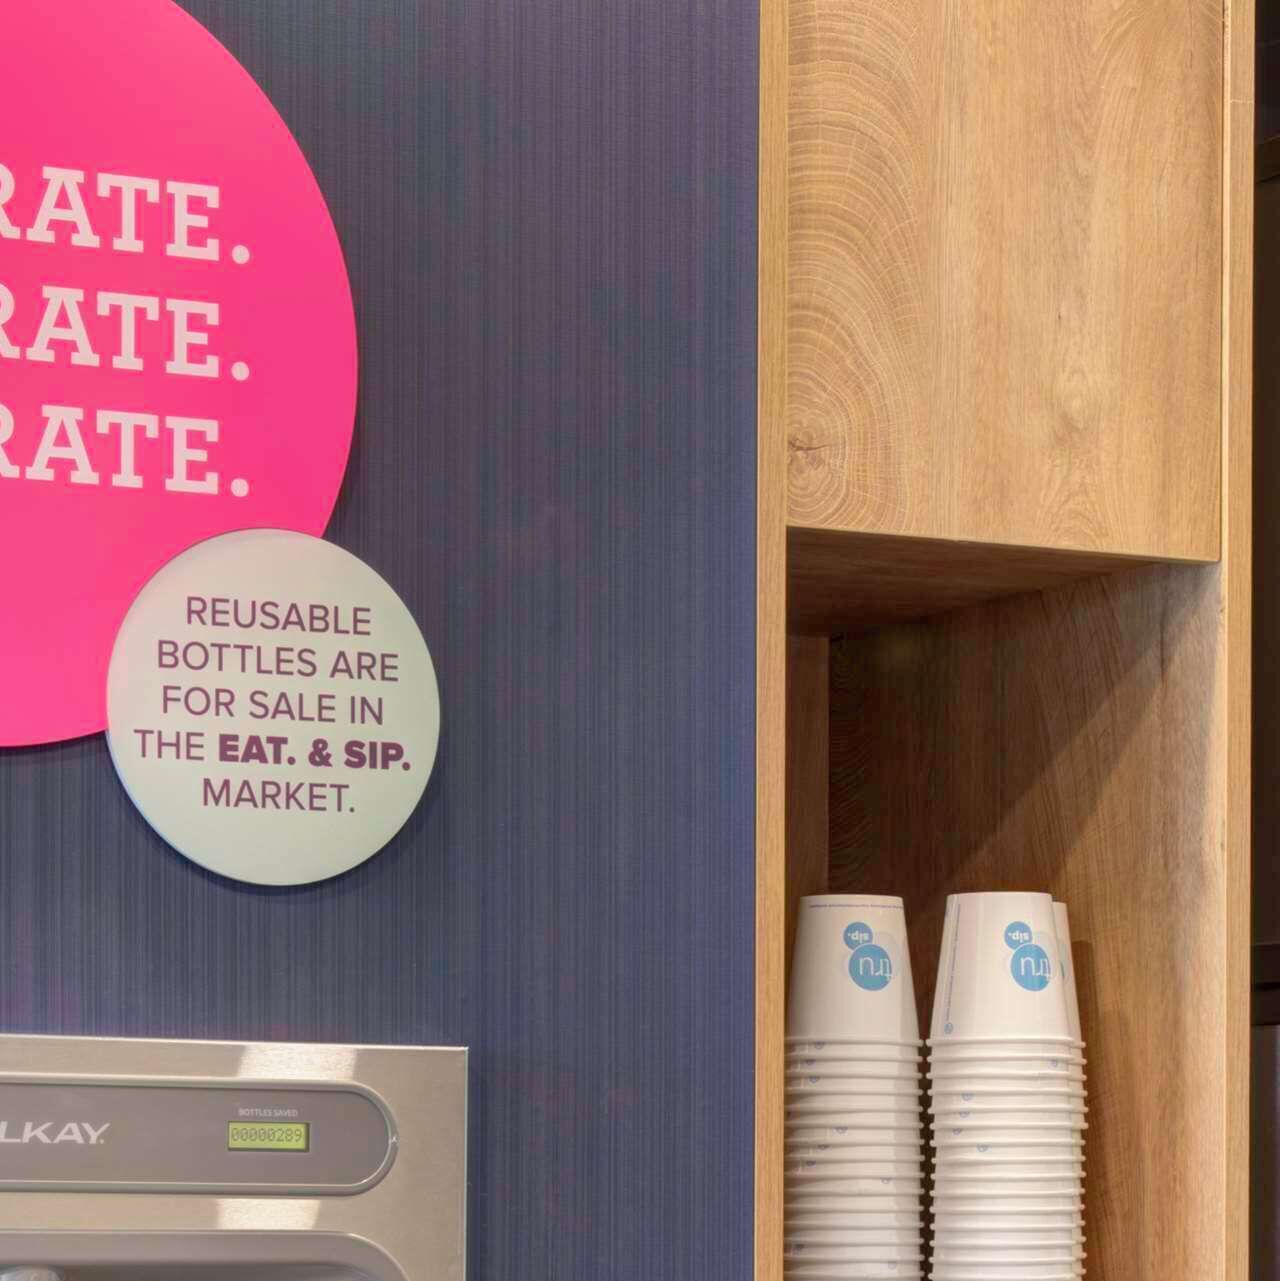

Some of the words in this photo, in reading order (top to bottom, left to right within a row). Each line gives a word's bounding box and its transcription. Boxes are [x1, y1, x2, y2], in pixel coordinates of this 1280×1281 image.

[186, 596, 371, 636] REUSABLE
[157, 639, 318, 678] BOTTLES
[329, 650, 399, 682] ARE
[162, 685, 235, 718] FOR
[248, 689, 336, 723] SALE
[349, 695, 384, 726] IN
[133, 728, 205, 761] THE
[218, 733, 297, 766] EAT.
[307, 737, 334, 768] &
[343, 739, 411, 771] SIP.
[202, 777, 355, 814] MARKET.
[237, 1108, 272, 1118] BOTTLES
[272, 1108, 299, 1118] SAVED
